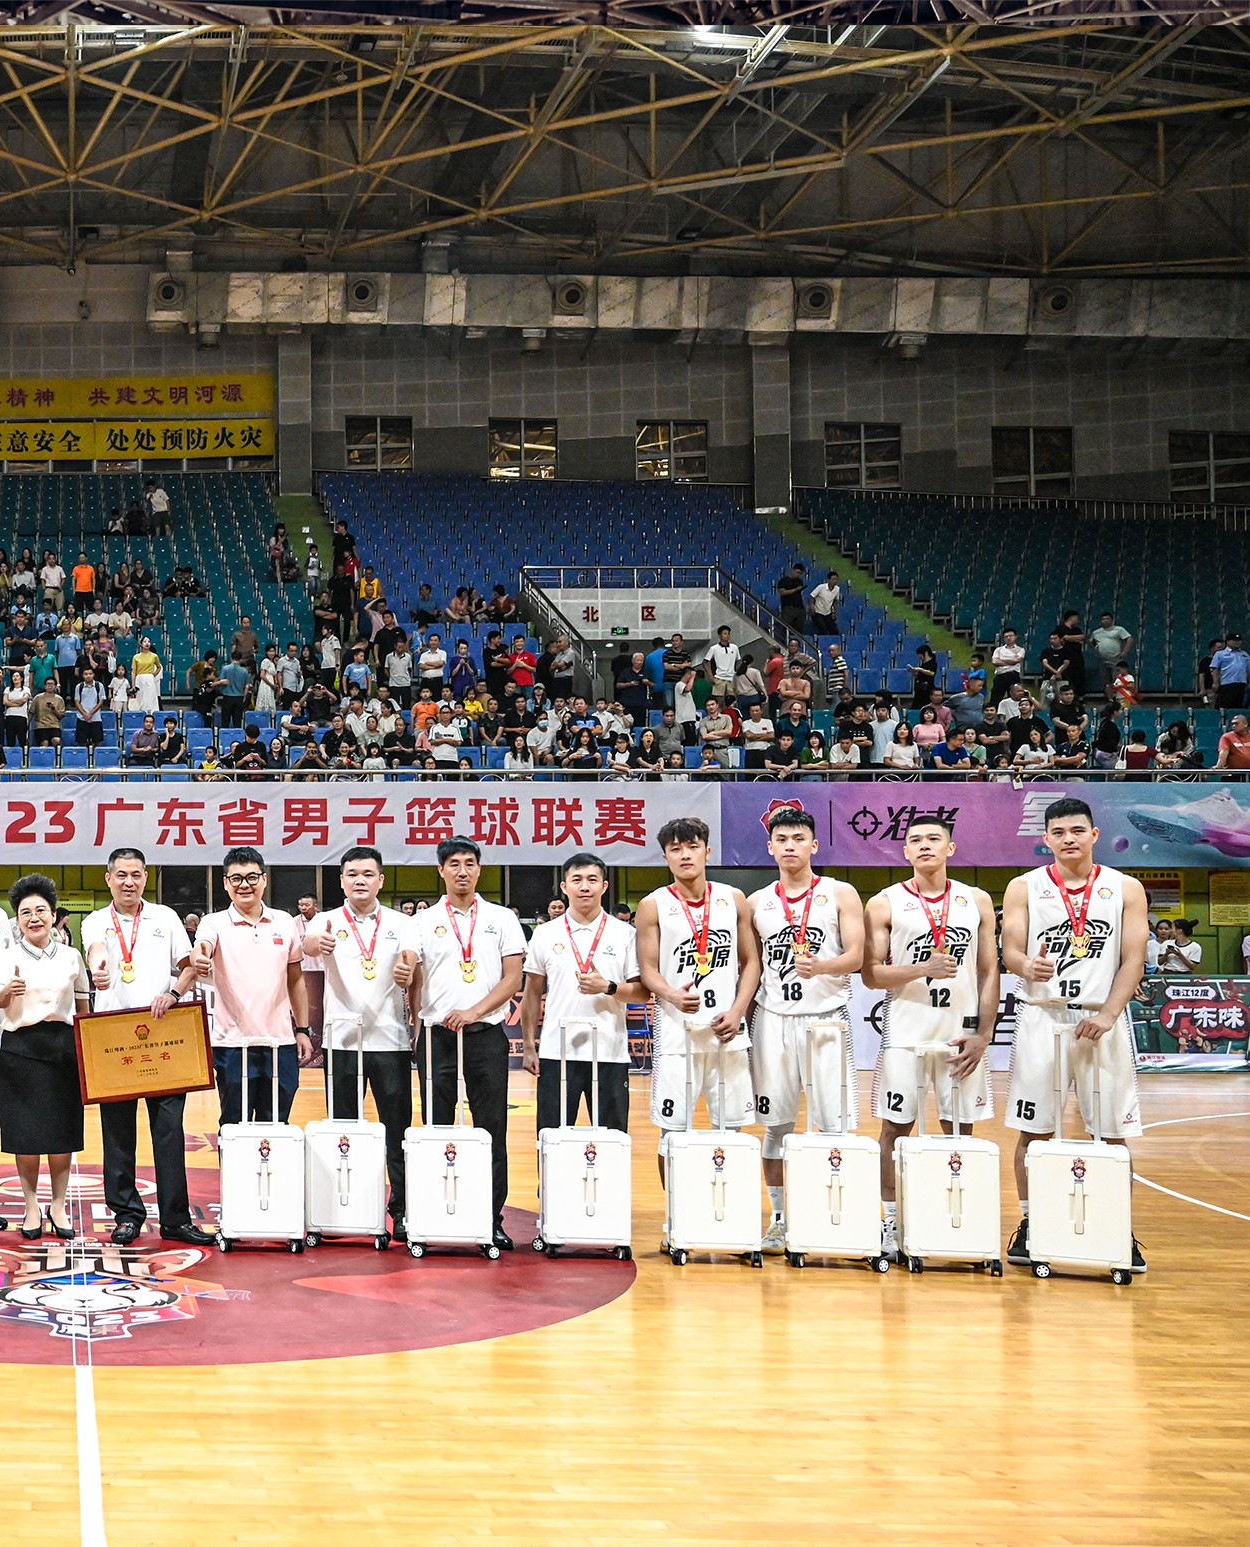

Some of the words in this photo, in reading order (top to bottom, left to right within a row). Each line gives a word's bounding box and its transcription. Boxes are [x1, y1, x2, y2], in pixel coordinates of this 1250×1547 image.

[88, 383, 244, 407] 共建文明河源
[105, 425, 263, 452] 处处预防火灾
[703, 989, 717, 1008] 8
[781, 982, 803, 1001] 18
[929, 988, 951, 1008] 12
[1059, 979, 1081, 998] 15
[1171, 988, 1210, 997] 珠江12度
[1166, 1004, 1245, 1029] 广东味
[121, 1051, 171, 1066] 第三名
[661, 1098, 674, 1118] 8
[886, 1091, 904, 1113] 12
[1016, 1099, 1036, 1121] 15
